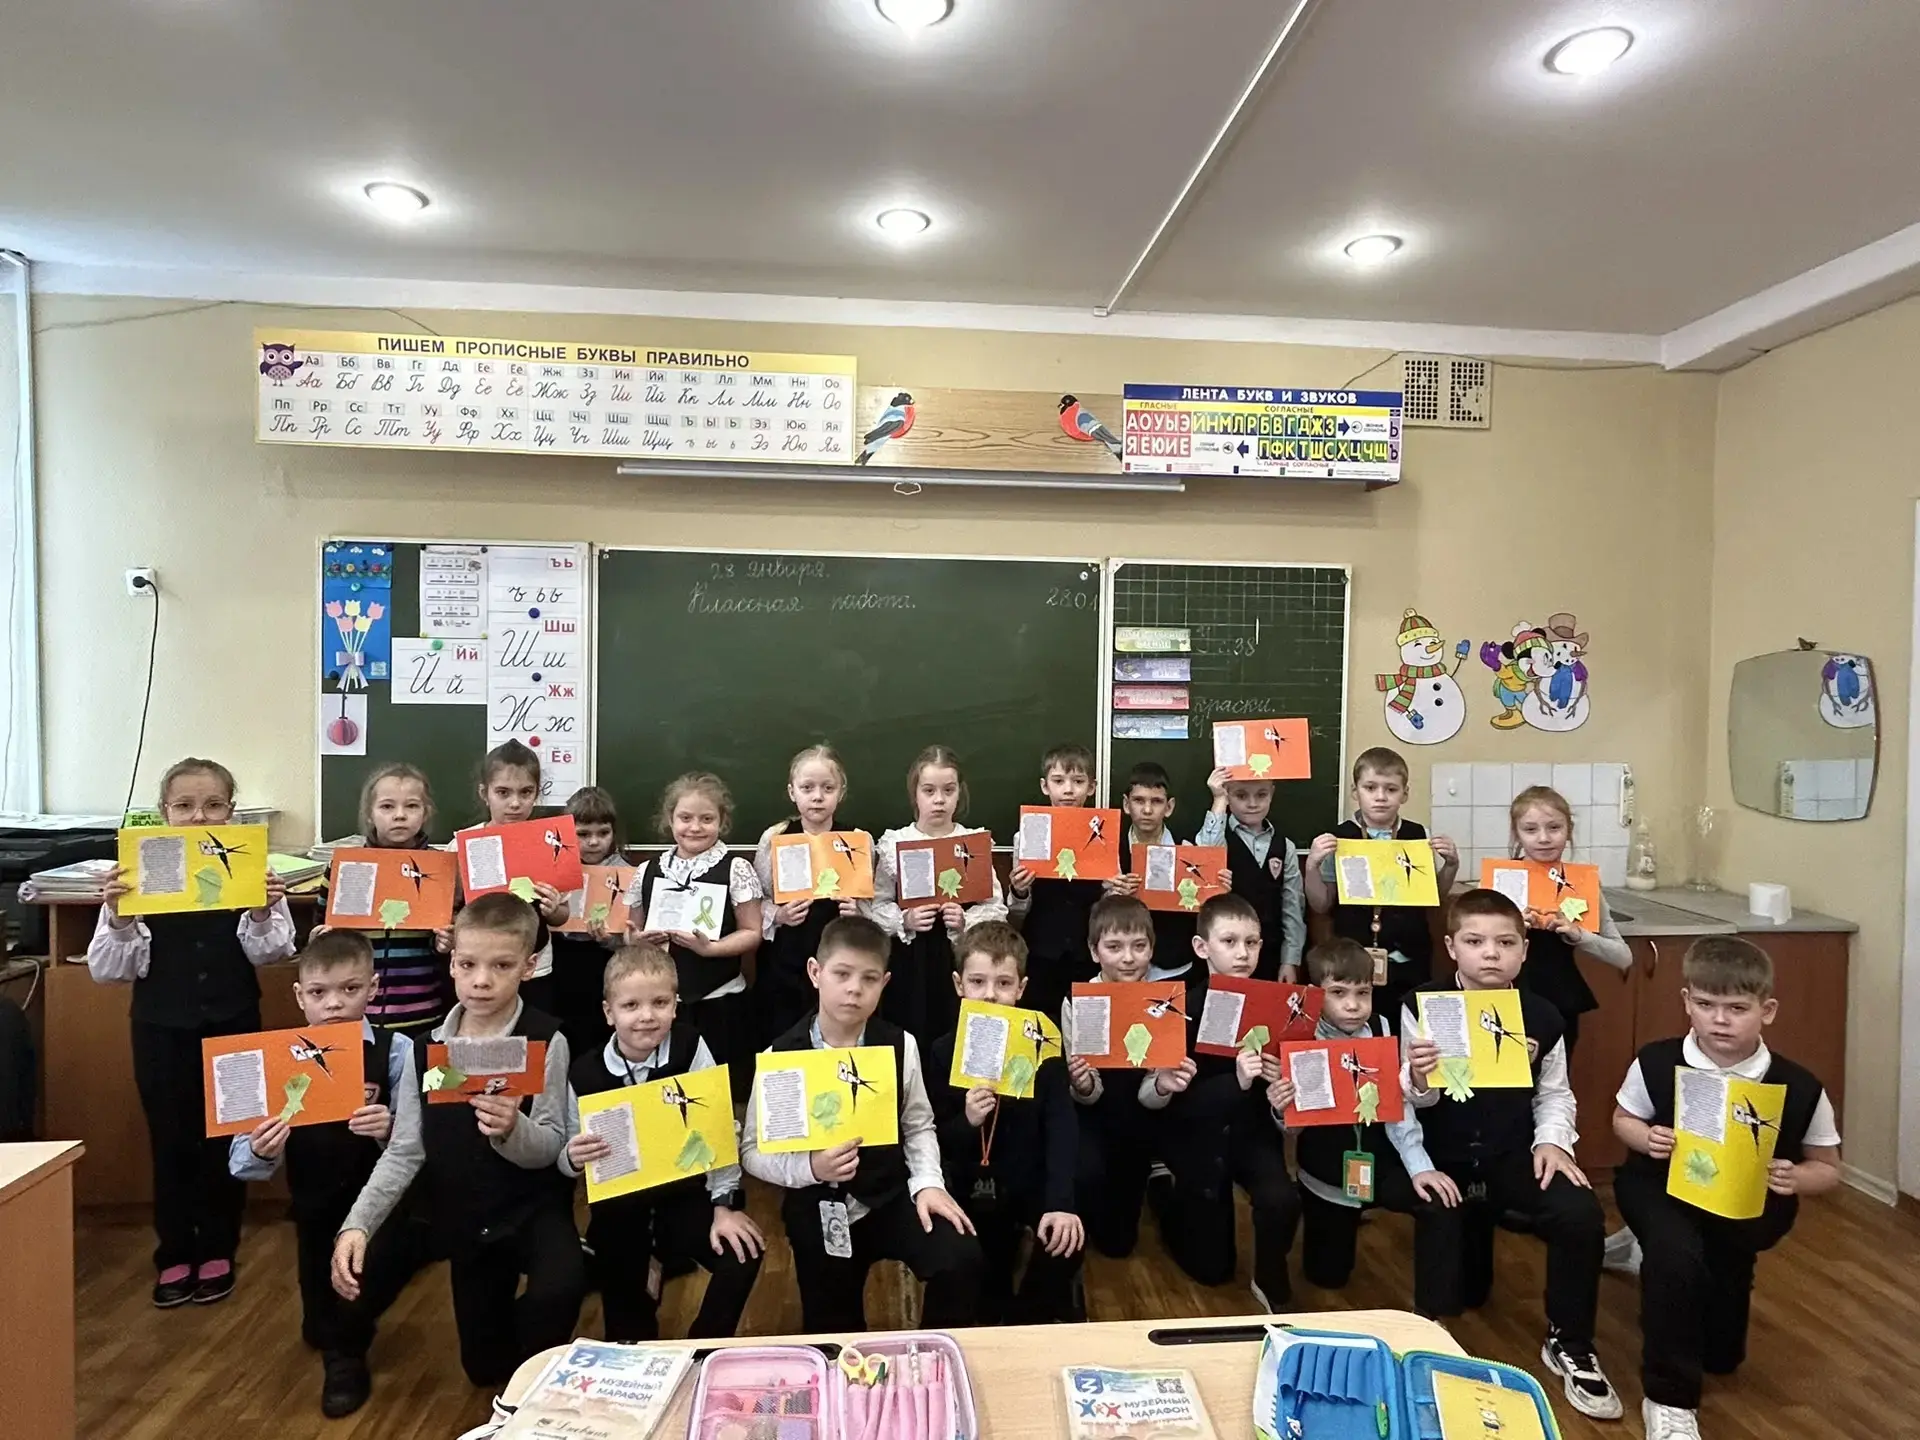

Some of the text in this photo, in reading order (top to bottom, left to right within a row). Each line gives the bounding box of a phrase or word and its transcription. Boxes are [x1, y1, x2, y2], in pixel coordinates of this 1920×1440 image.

[378, 337, 749, 368] ПИШЕМ ПРОПИСНЫЕ БУКВЫ ПРАВИЛЬНО
[1182, 388, 1357, 404] ЛЕНТА БУКВ И ЗВУКОВ
[1140, 402, 1177, 410] ГЛАСНЫЕ
[711, 562, 735, 579] 28
[687, 581, 803, 614] Классная
[544, 620, 575, 632] Шш
[456, 646, 478, 660] Йй
[500, 630, 566, 668] Ш ш
[410, 652, 441, 694] Й
[447, 675, 464, 694] й
[549, 685, 574, 697] Жж
[493, 695, 574, 731] Ж ж
[551, 747, 572, 763] Ёё
[600, 1378, 663, 1390] МУЗЕЙНЫЙ
[597, 1388, 653, 1401] МАРАФОН
[1125, 1397, 1190, 1408] МУЗЕЙНЫЙ
[1131, 1407, 1189, 1418] МАРАФОН
